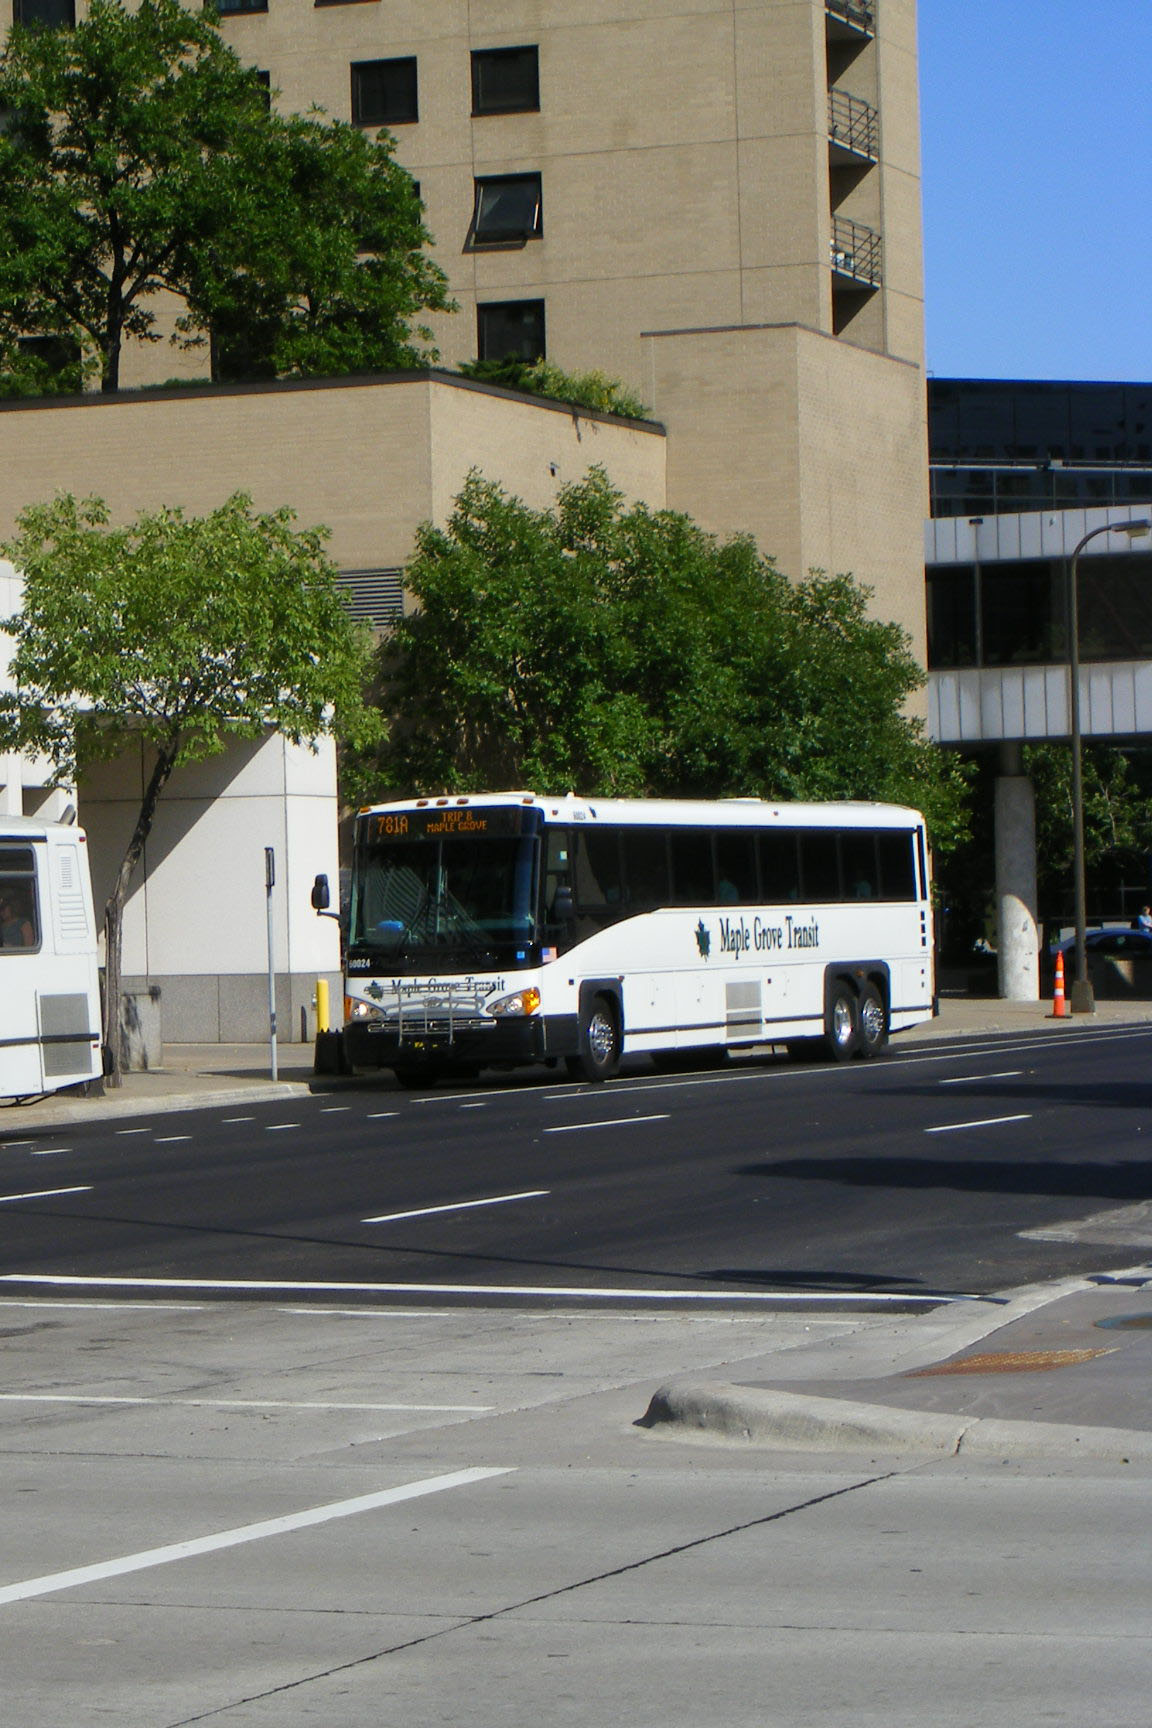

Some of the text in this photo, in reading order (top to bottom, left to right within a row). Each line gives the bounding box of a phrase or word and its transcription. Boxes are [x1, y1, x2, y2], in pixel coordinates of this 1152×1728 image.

[376, 815, 408, 835] 781A
[441, 811, 463, 823] TRIP
[426, 820, 488, 833] MAPLE GROVE
[719, 914, 819, 960] Maple Grove Transit
